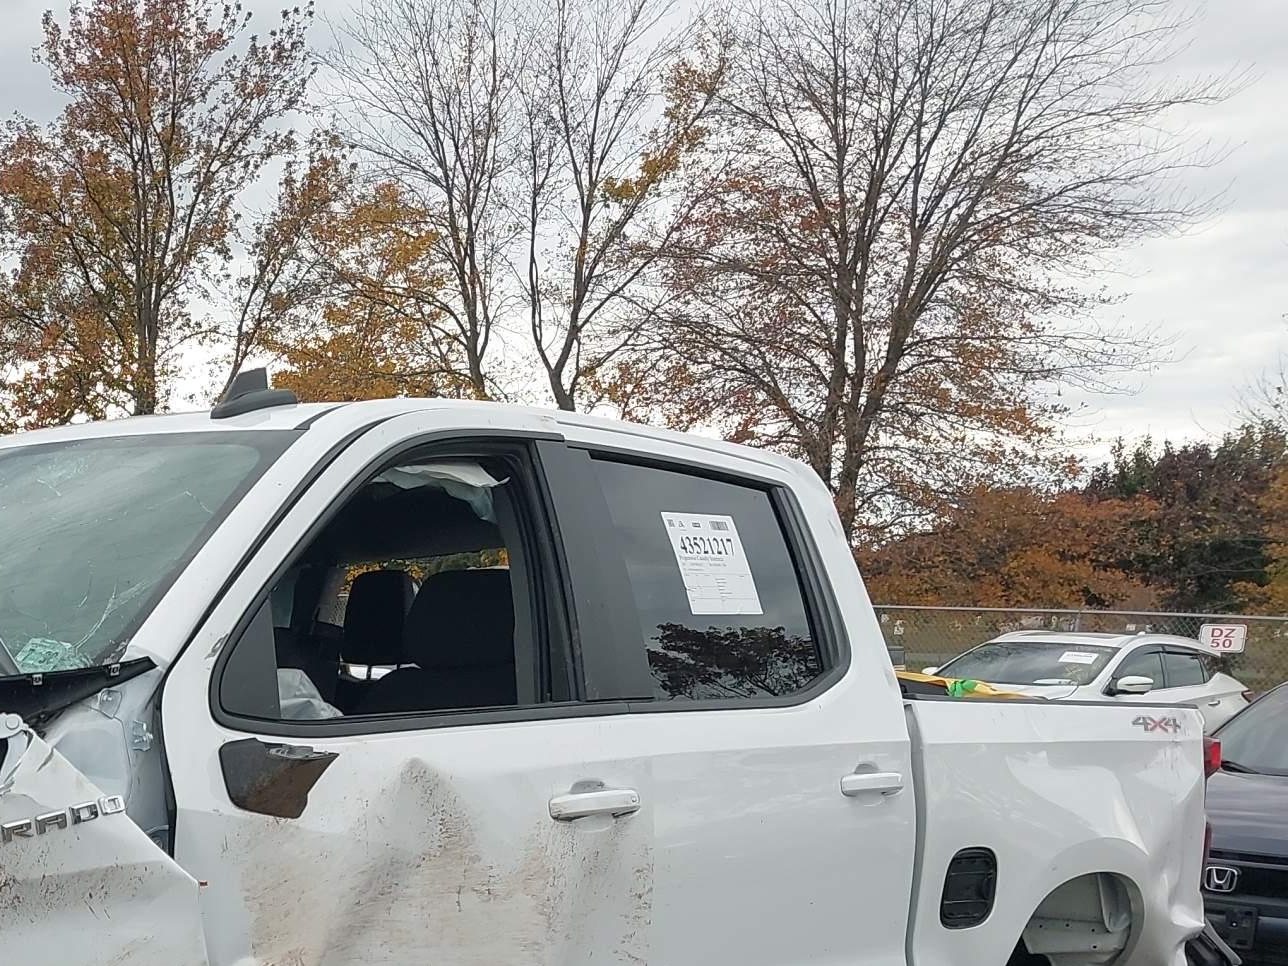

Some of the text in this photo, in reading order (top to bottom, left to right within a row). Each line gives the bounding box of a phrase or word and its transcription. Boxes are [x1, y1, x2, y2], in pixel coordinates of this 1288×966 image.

[680, 536, 734, 555] 43521217
[1210, 627, 1237, 638] DZ
[1210, 638, 1233, 648] 50
